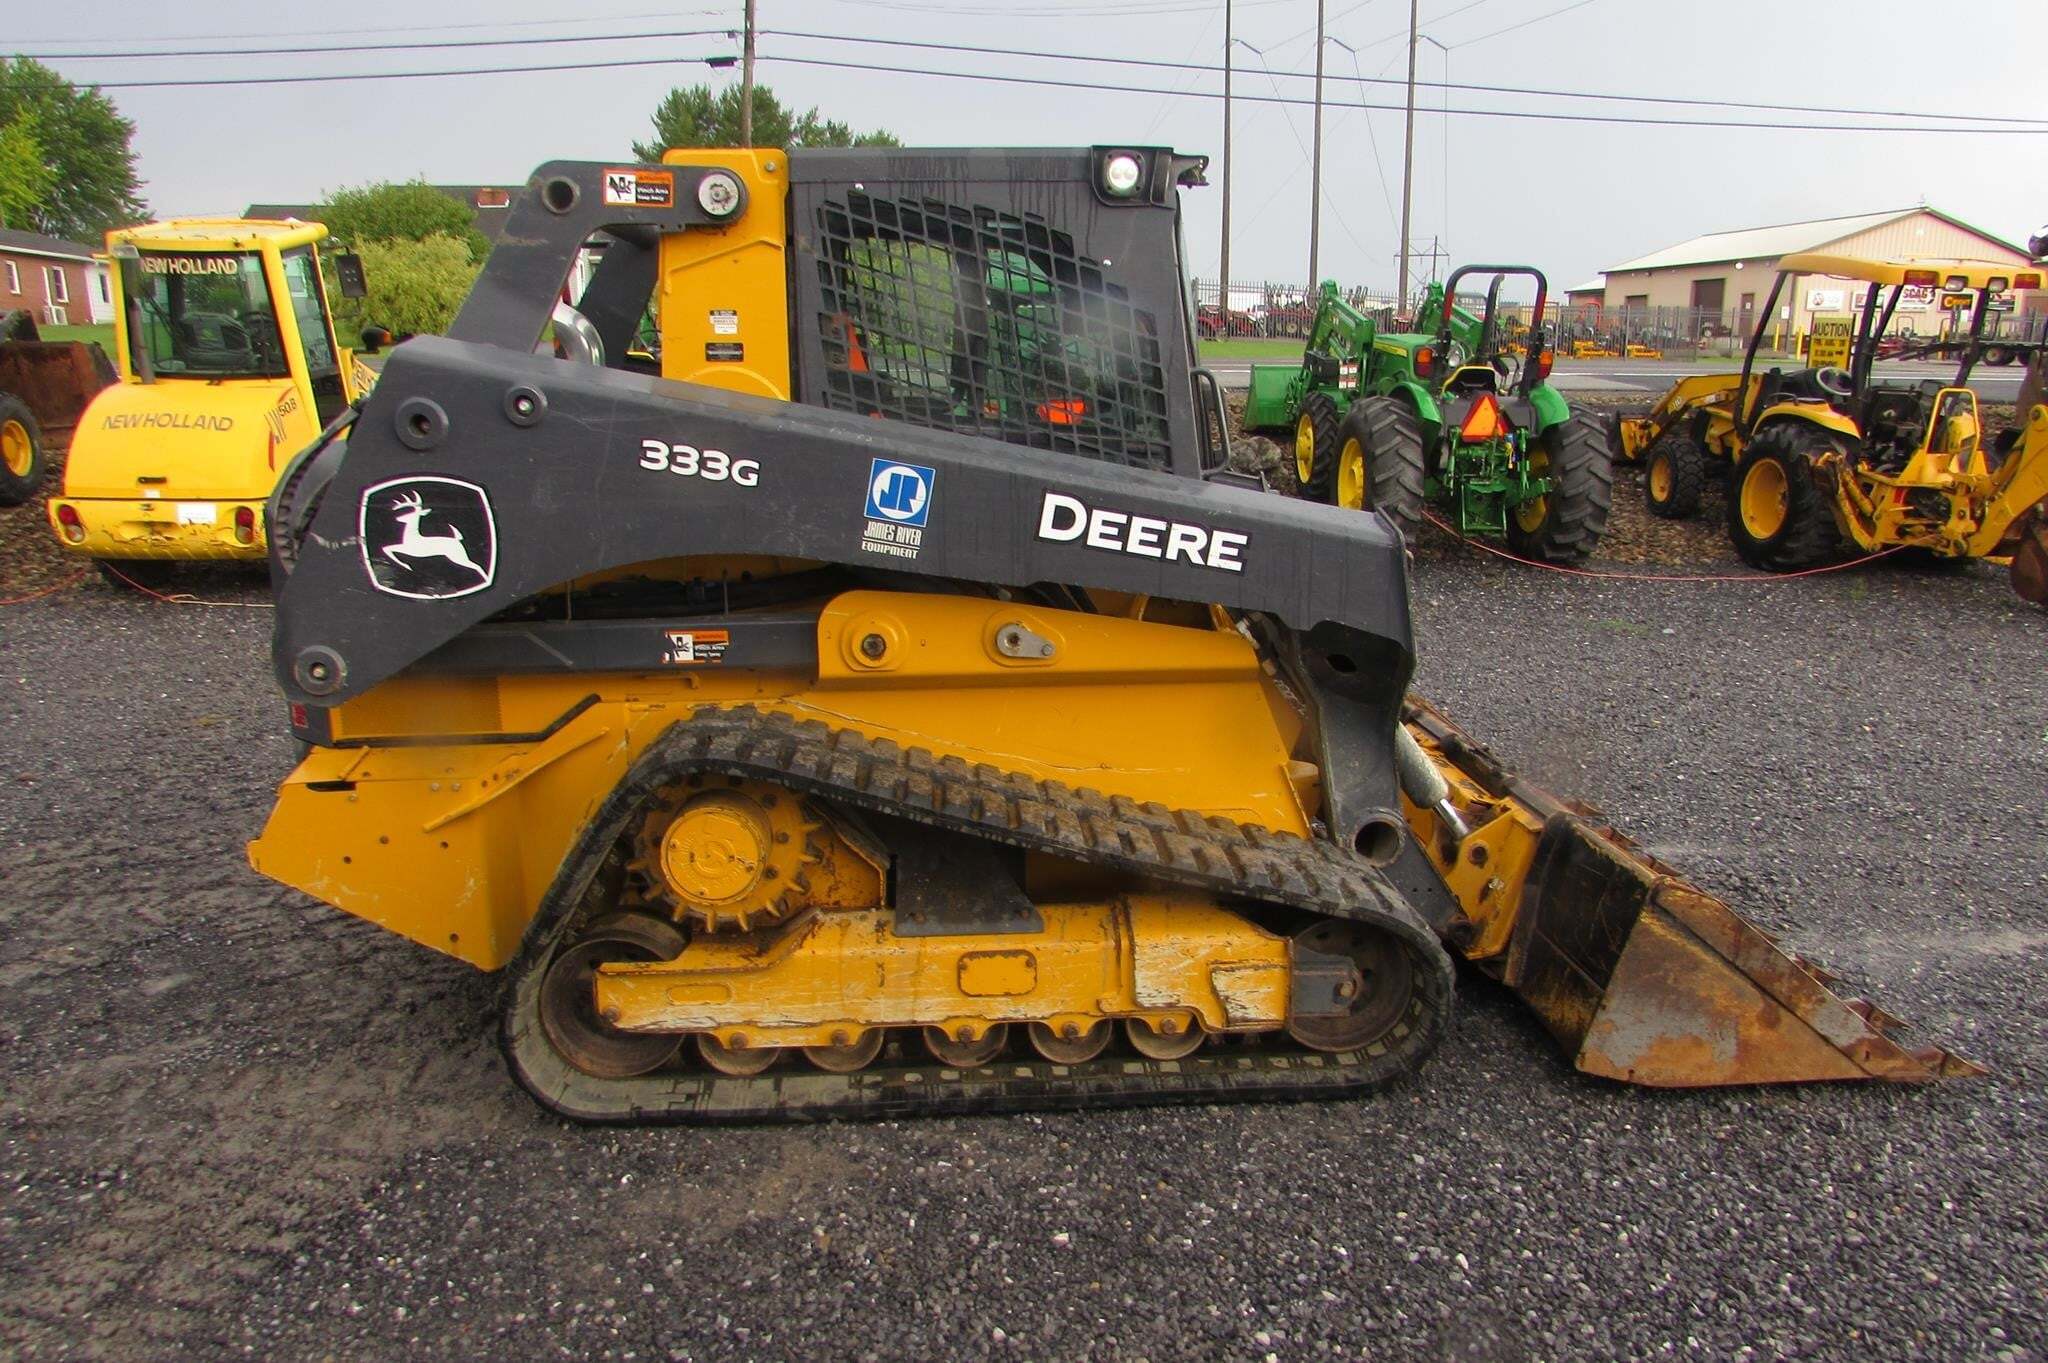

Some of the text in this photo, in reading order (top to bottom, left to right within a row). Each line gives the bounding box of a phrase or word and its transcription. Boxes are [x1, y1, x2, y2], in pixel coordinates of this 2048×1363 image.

[168, 257, 238, 275] HOLLAND
[1812, 321, 1850, 337] AUCTION
[102, 412, 233, 432] NEW HOLLAND
[639, 439, 760, 487] 333G
[863, 520, 922, 546] JAMES RIVER
[1038, 492, 1248, 572] DEERE
[861, 541, 918, 559] EQUIPMENT
